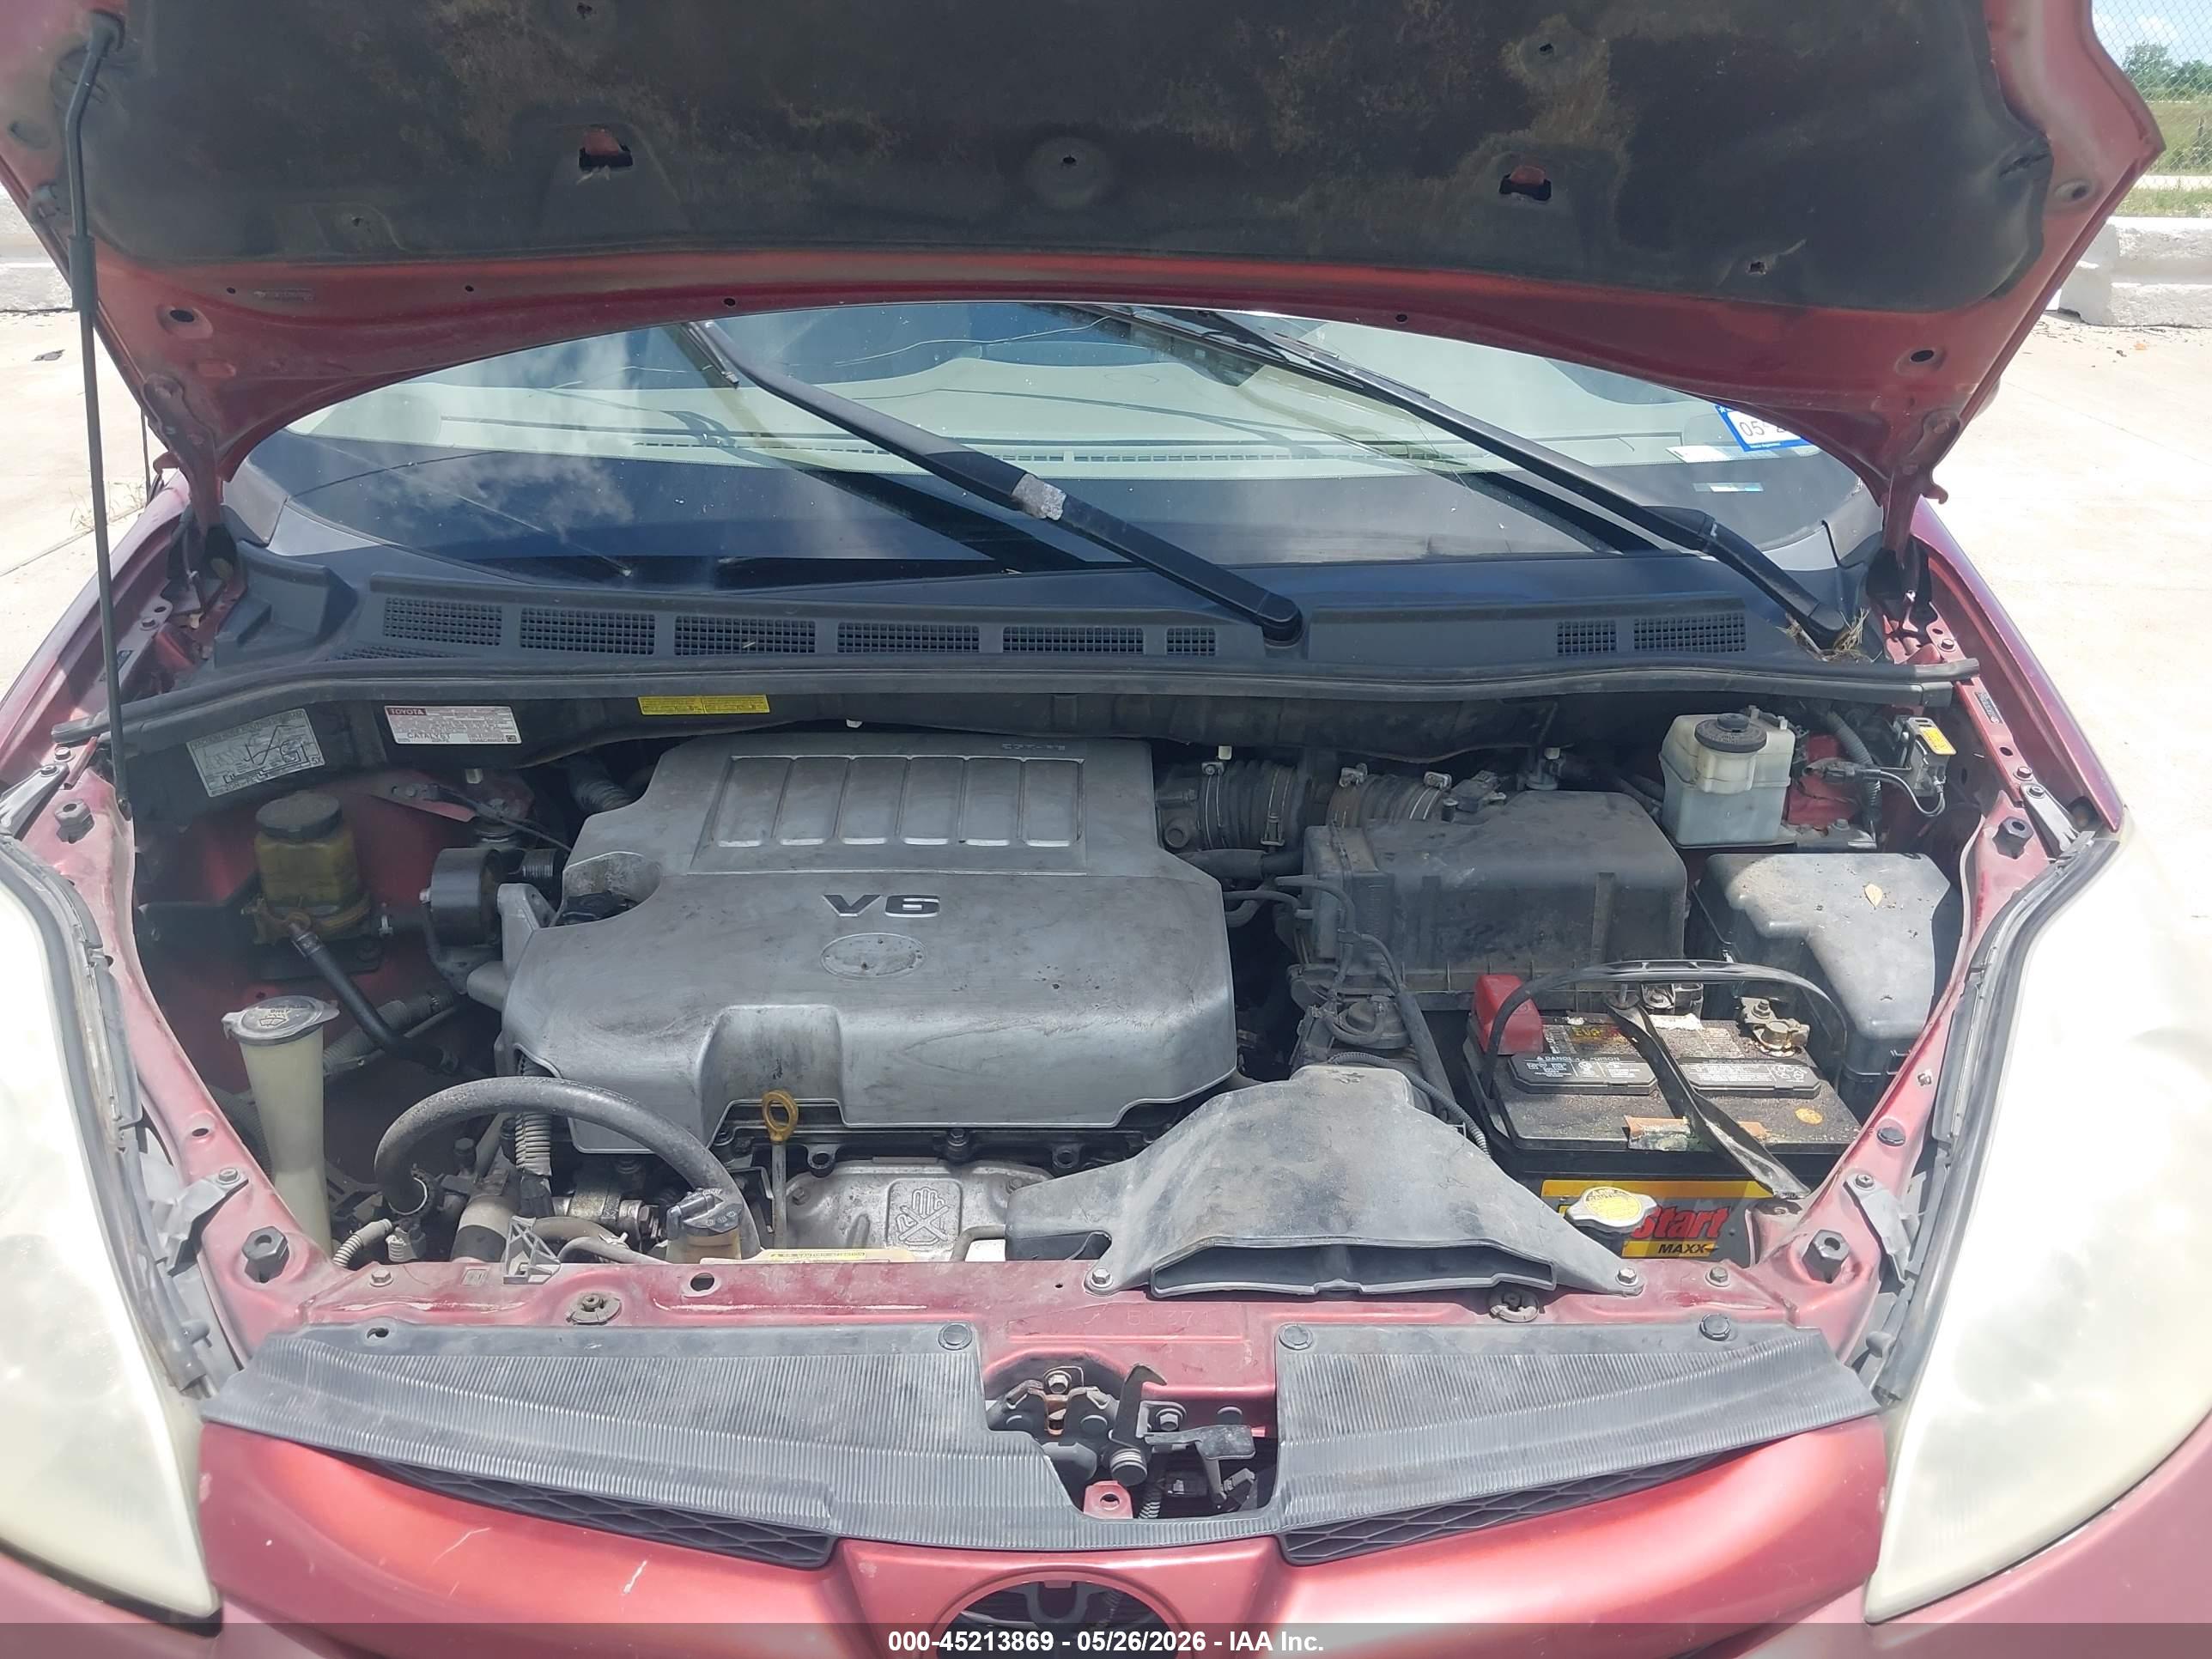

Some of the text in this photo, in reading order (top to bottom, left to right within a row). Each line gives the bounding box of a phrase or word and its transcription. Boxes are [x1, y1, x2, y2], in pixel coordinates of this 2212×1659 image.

[1739, 421, 1765, 436] 05
[822, 894, 940, 917] V6
[1657, 1244, 1706, 1254] MAXX
